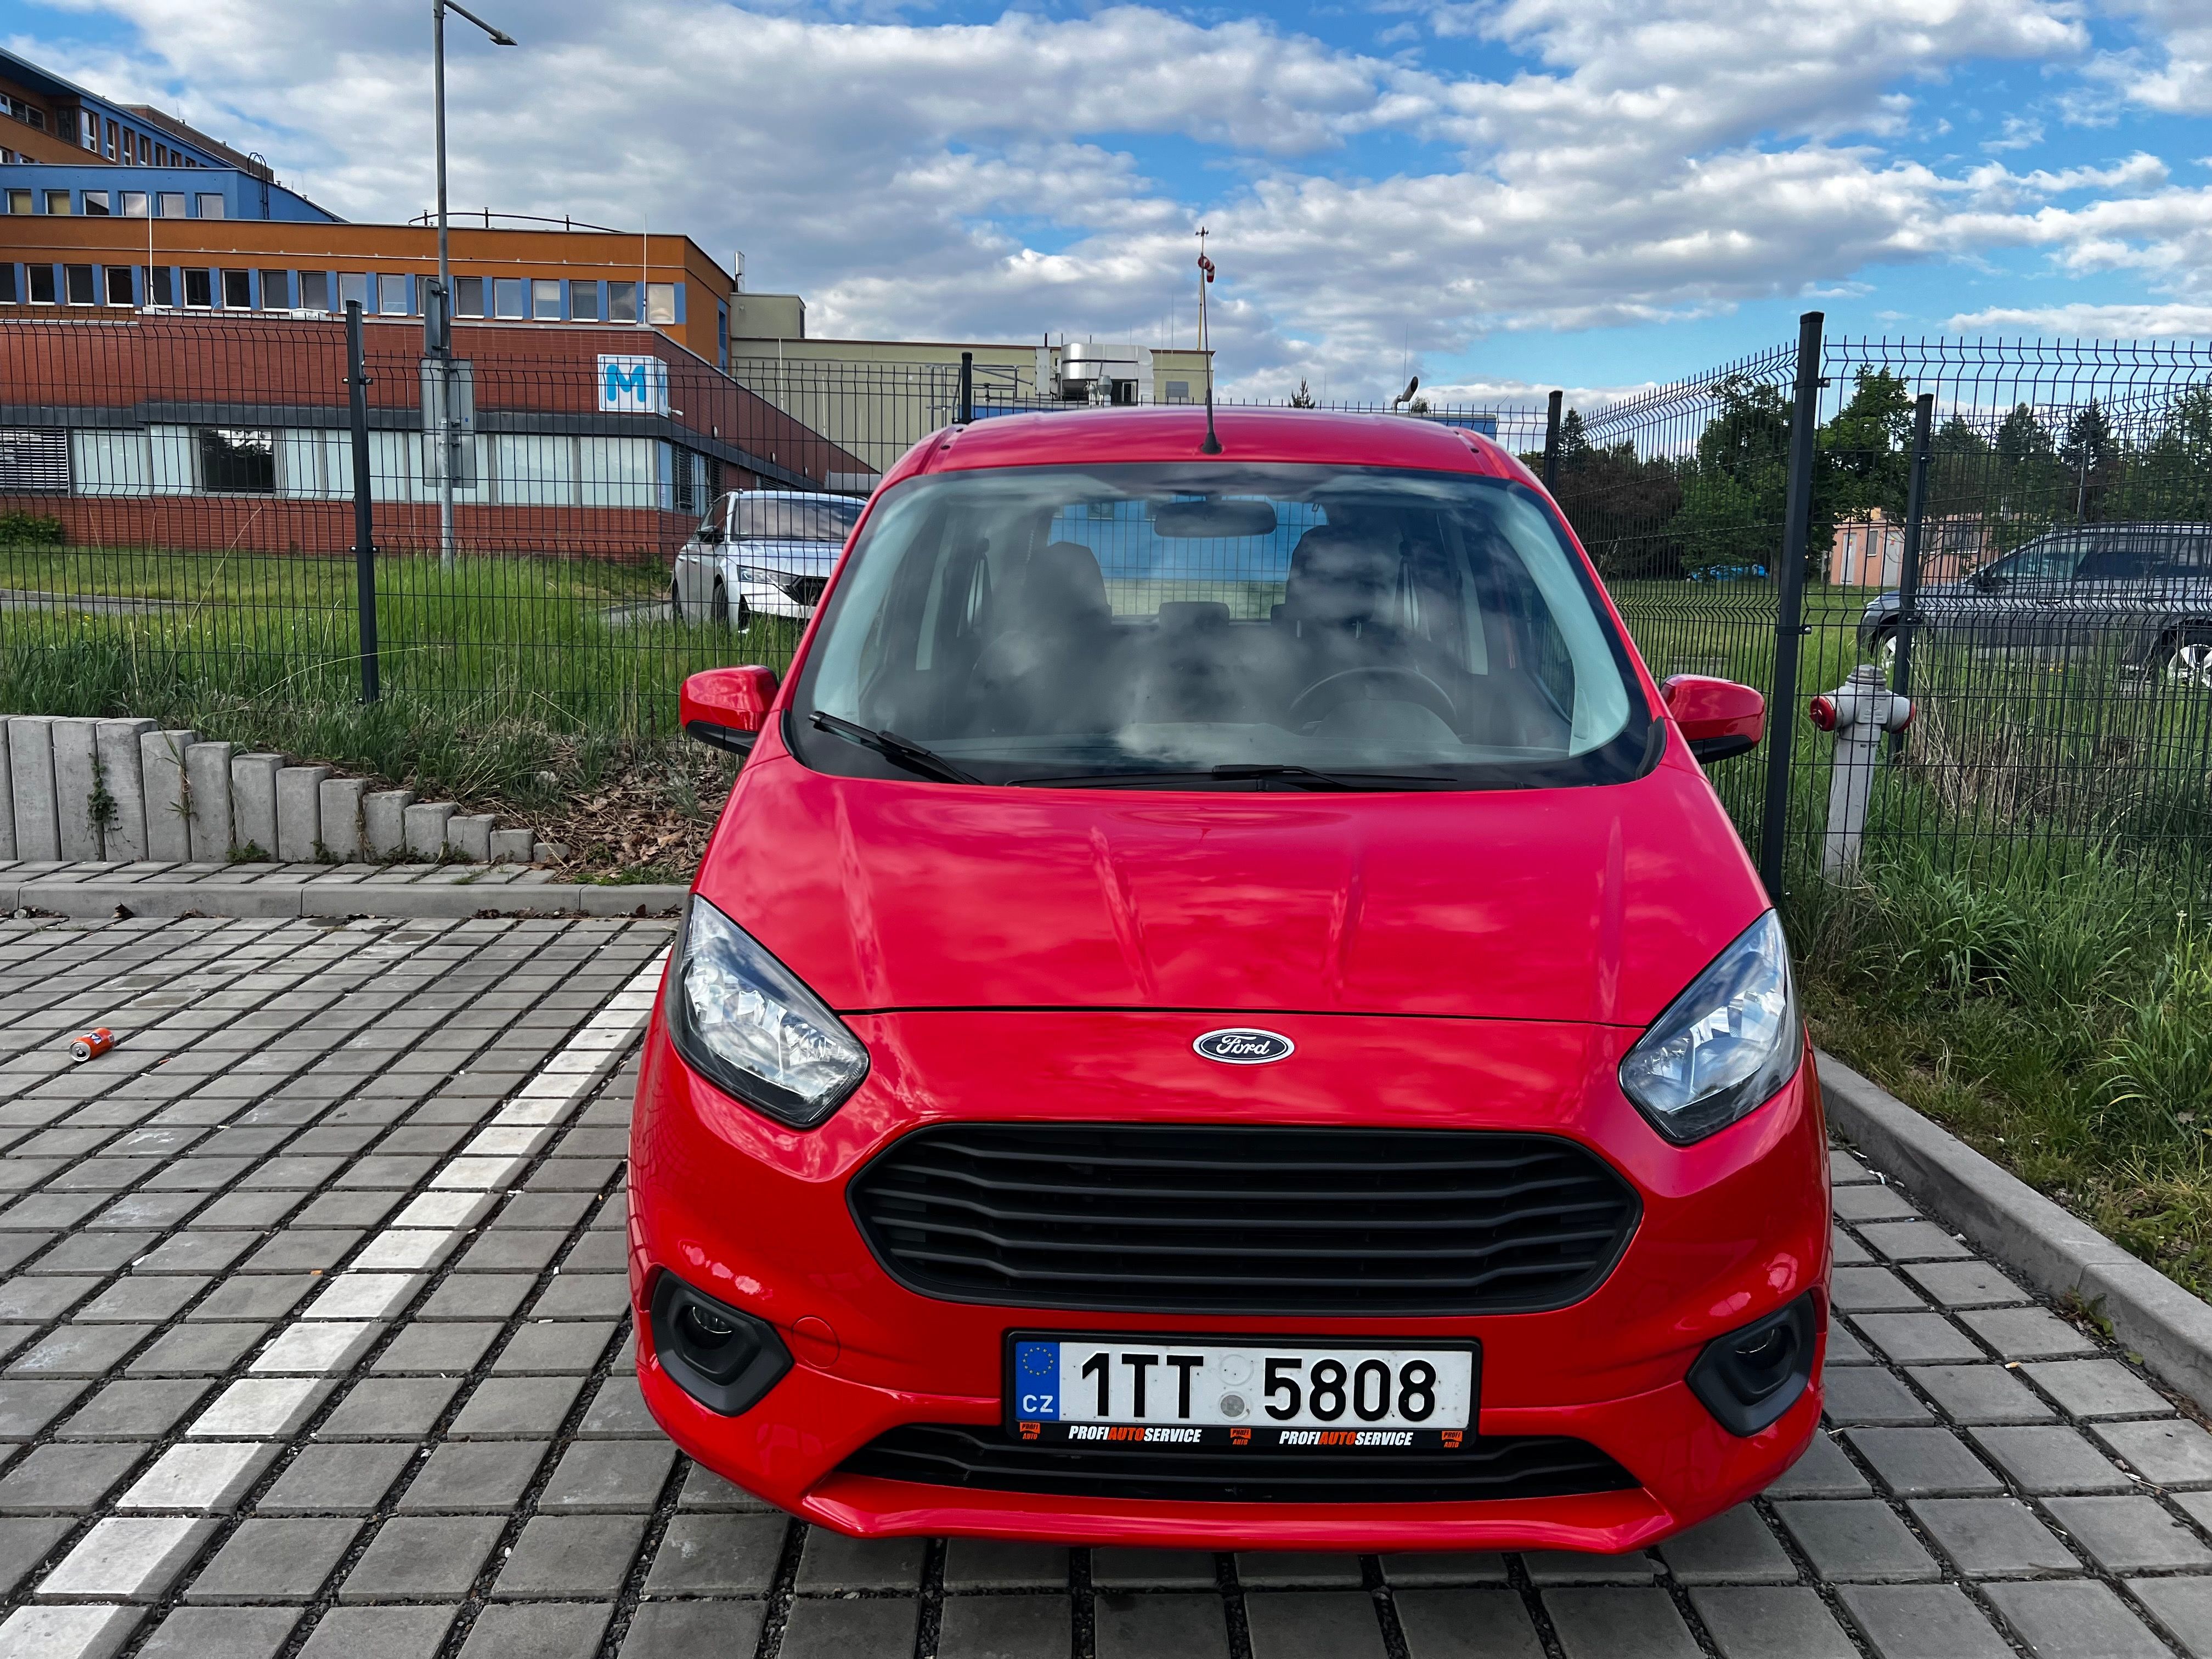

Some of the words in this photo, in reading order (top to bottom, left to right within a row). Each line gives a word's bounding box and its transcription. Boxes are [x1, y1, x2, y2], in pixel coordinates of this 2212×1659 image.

[607, 365, 646, 402] M
[1216, 1035, 1271, 1054] Ford
[1081, 1352, 1204, 1418] 1TT
[1264, 1357, 1437, 1422] 5808
[1023, 1395, 1053, 1413] CZ
[1068, 1425, 1202, 1442] PROFIAUTOSERVICE
[1279, 1431, 1413, 1446] PROFIAUTOSERVICE
